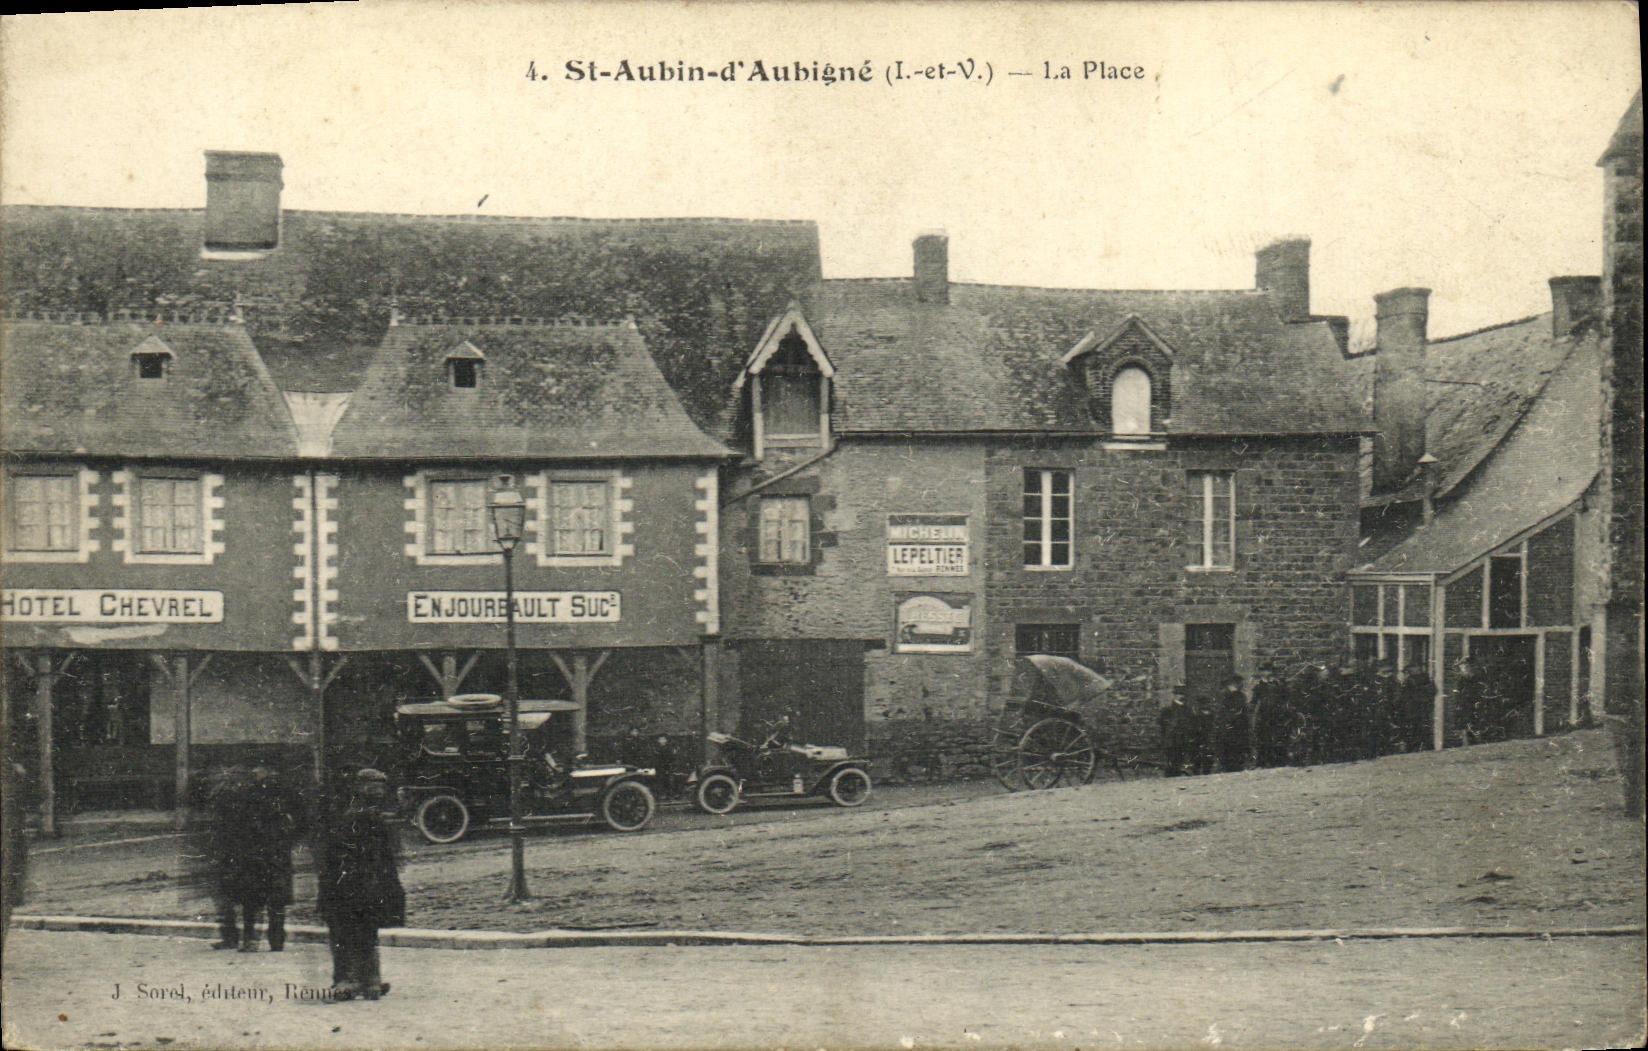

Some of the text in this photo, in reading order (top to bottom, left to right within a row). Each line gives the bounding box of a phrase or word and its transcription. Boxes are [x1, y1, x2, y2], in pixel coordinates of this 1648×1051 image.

[890, 526, 965, 539] MICHELIN
[893, 547, 963, 565] LEPELTIER
[1, 592, 213, 617] HOTEL CHEVREL
